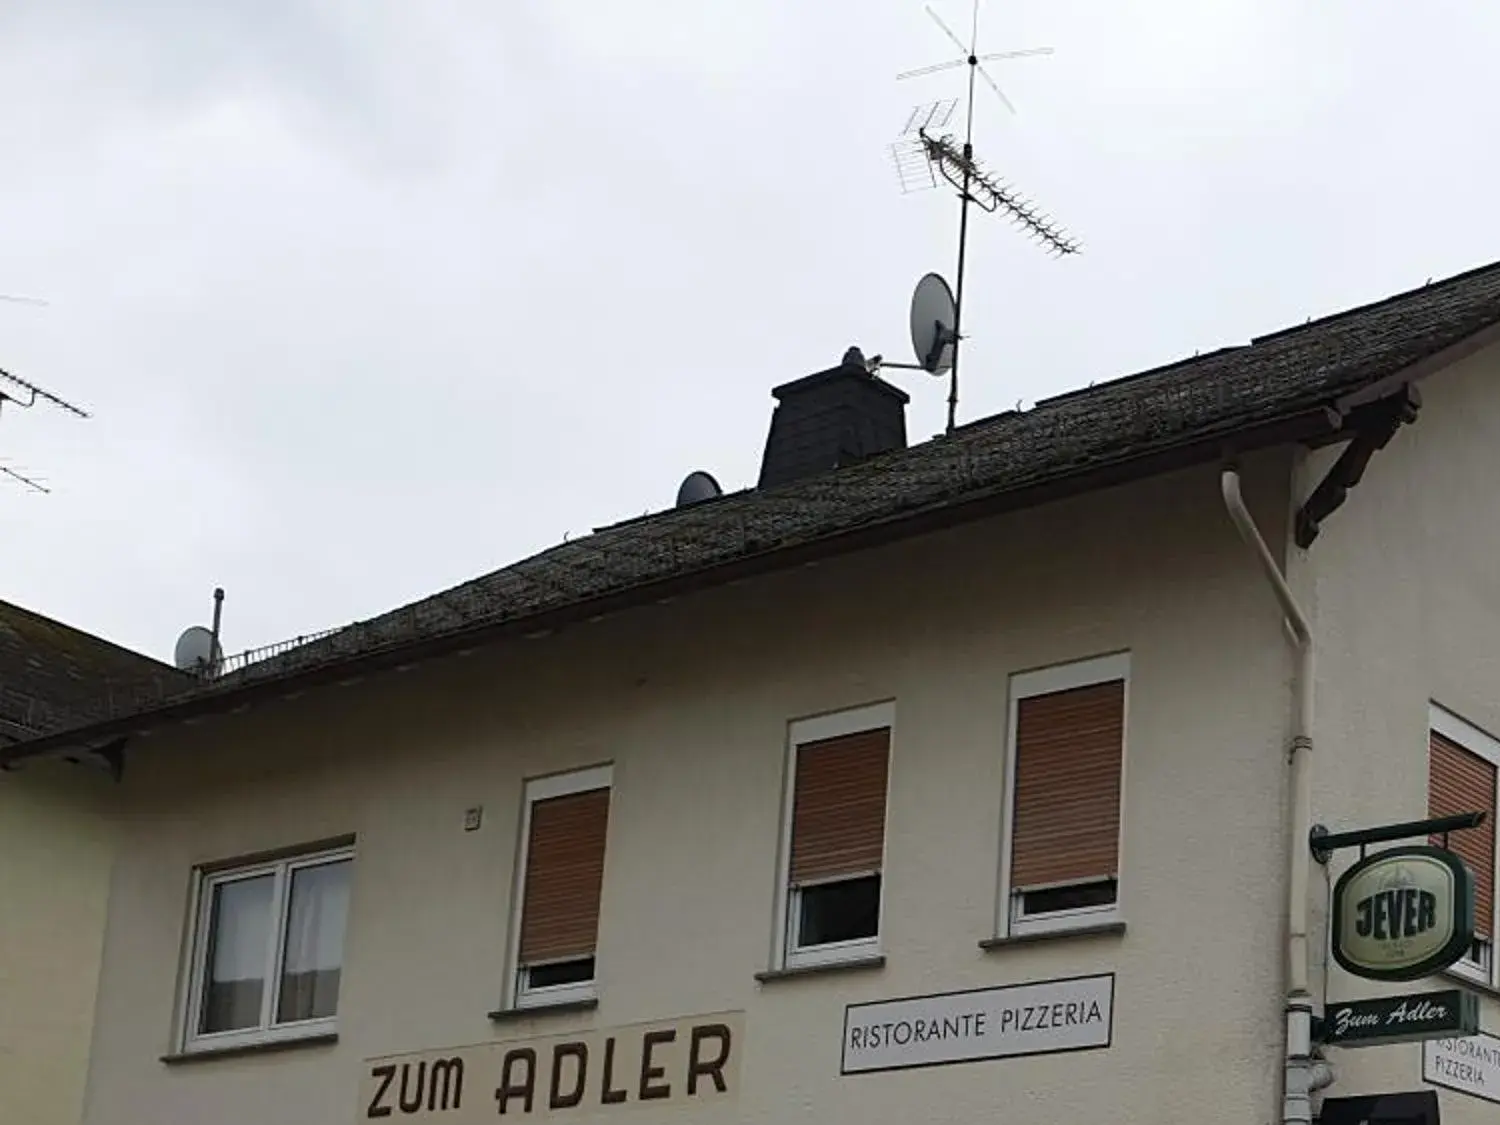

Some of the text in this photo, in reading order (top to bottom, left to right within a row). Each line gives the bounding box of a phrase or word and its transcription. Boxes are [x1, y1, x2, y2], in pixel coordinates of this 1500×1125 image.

[1355, 887, 1437, 940] JEVER
[850, 1000, 1103, 1049] RISTORANTE PIZZERIA
[1334, 1000, 1449, 1036] Zum Adler
[367, 1022, 733, 1119] ZUM ADLER
[1434, 1055, 1485, 1087] PIZZERIA
